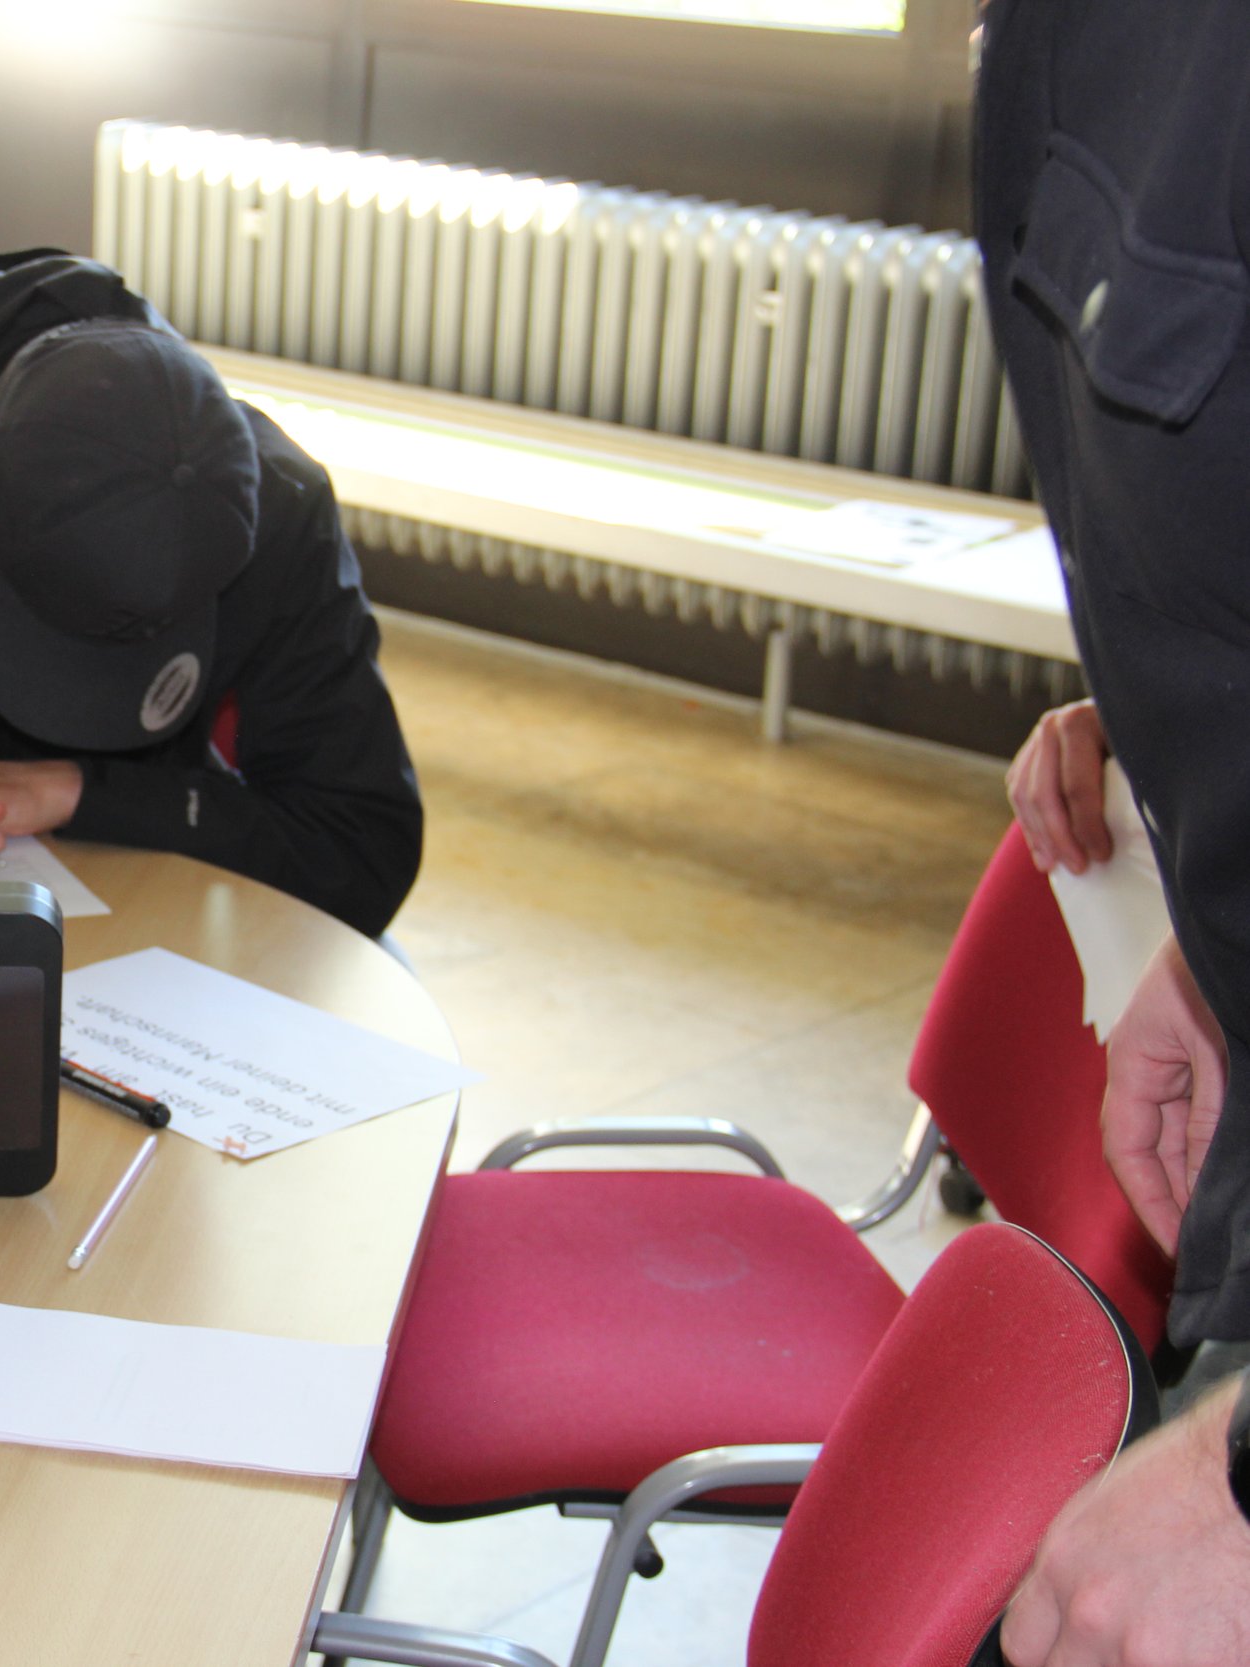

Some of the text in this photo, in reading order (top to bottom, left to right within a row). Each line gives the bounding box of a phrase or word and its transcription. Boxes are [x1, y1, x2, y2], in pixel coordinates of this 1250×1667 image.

[77, 1028, 195, 1079] wichtiges
[199, 1076, 241, 1099] ein
[232, 1056, 309, 1093] deiner
[244, 1097, 315, 1130] ende
[311, 1092, 356, 1115] mit
[227, 1122, 273, 1145] Du
